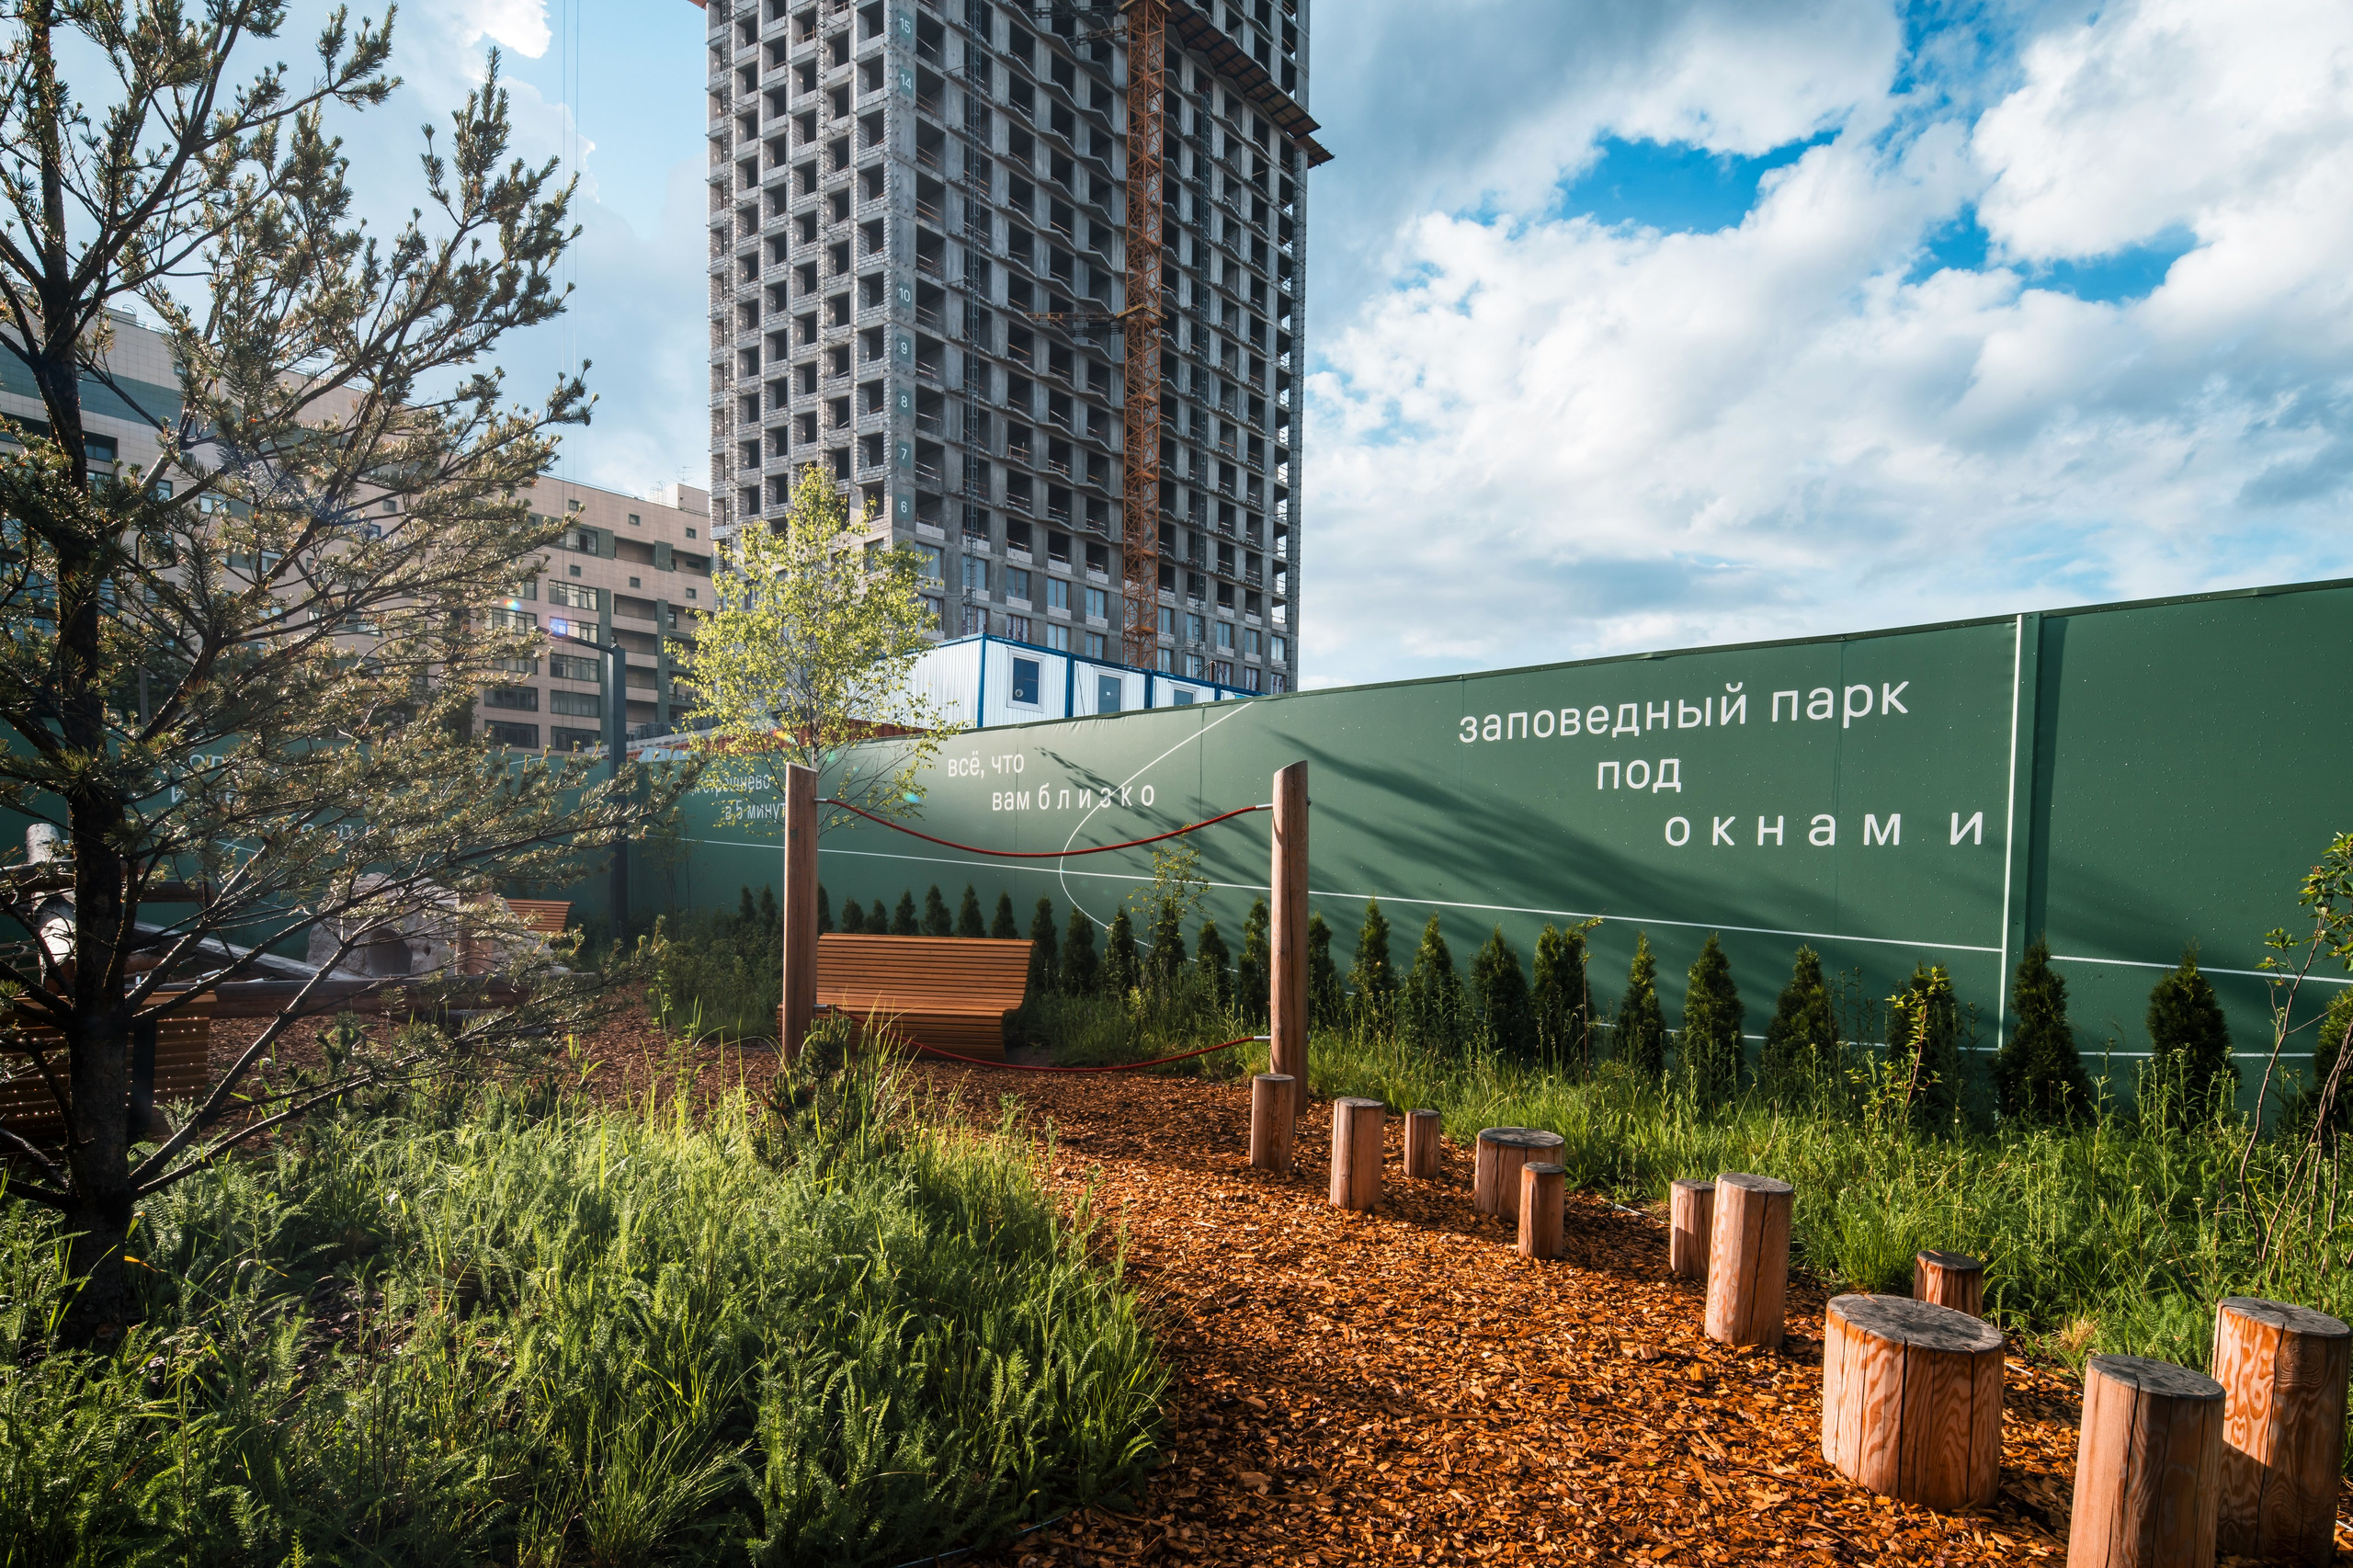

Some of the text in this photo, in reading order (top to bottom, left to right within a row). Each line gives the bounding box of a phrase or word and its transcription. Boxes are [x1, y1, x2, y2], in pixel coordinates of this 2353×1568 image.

[900, 17, 911, 34] 15
[901, 74, 912, 90] 14
[899, 287, 911, 302] 10
[901, 341, 908, 355] 9
[901, 395, 908, 408] 8
[901, 448, 907, 460] 7
[901, 500, 908, 514] 6
[1459, 681, 1910, 743] заповедный парк
[948, 750, 1024, 778] всё, что
[1597, 758, 1682, 793] под
[992, 782, 1155, 811] вам близко
[1665, 811, 1984, 846] окнами
